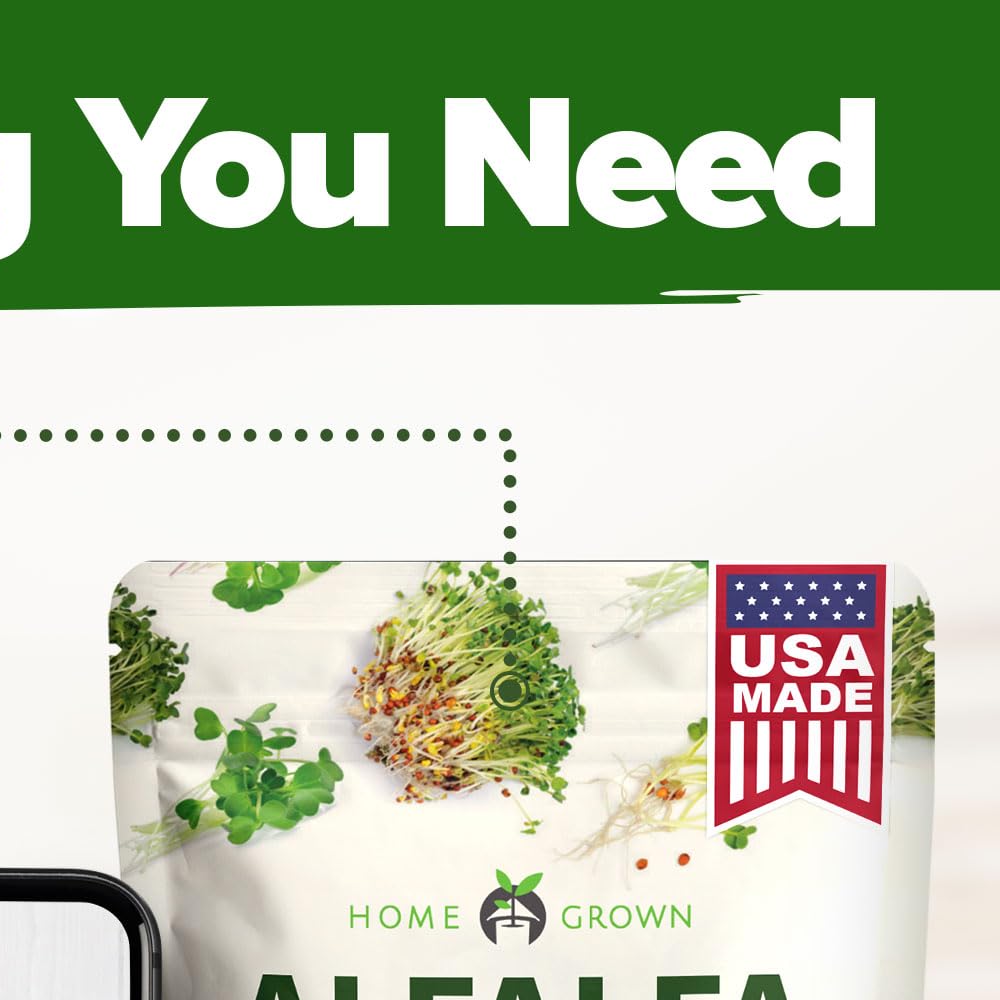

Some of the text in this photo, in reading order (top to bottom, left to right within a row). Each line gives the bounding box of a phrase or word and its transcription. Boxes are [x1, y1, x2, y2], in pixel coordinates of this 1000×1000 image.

[731, 634, 873, 677] USA
[734, 683, 872, 713] MADE
[350, 904, 691, 929] HOME GROWN
